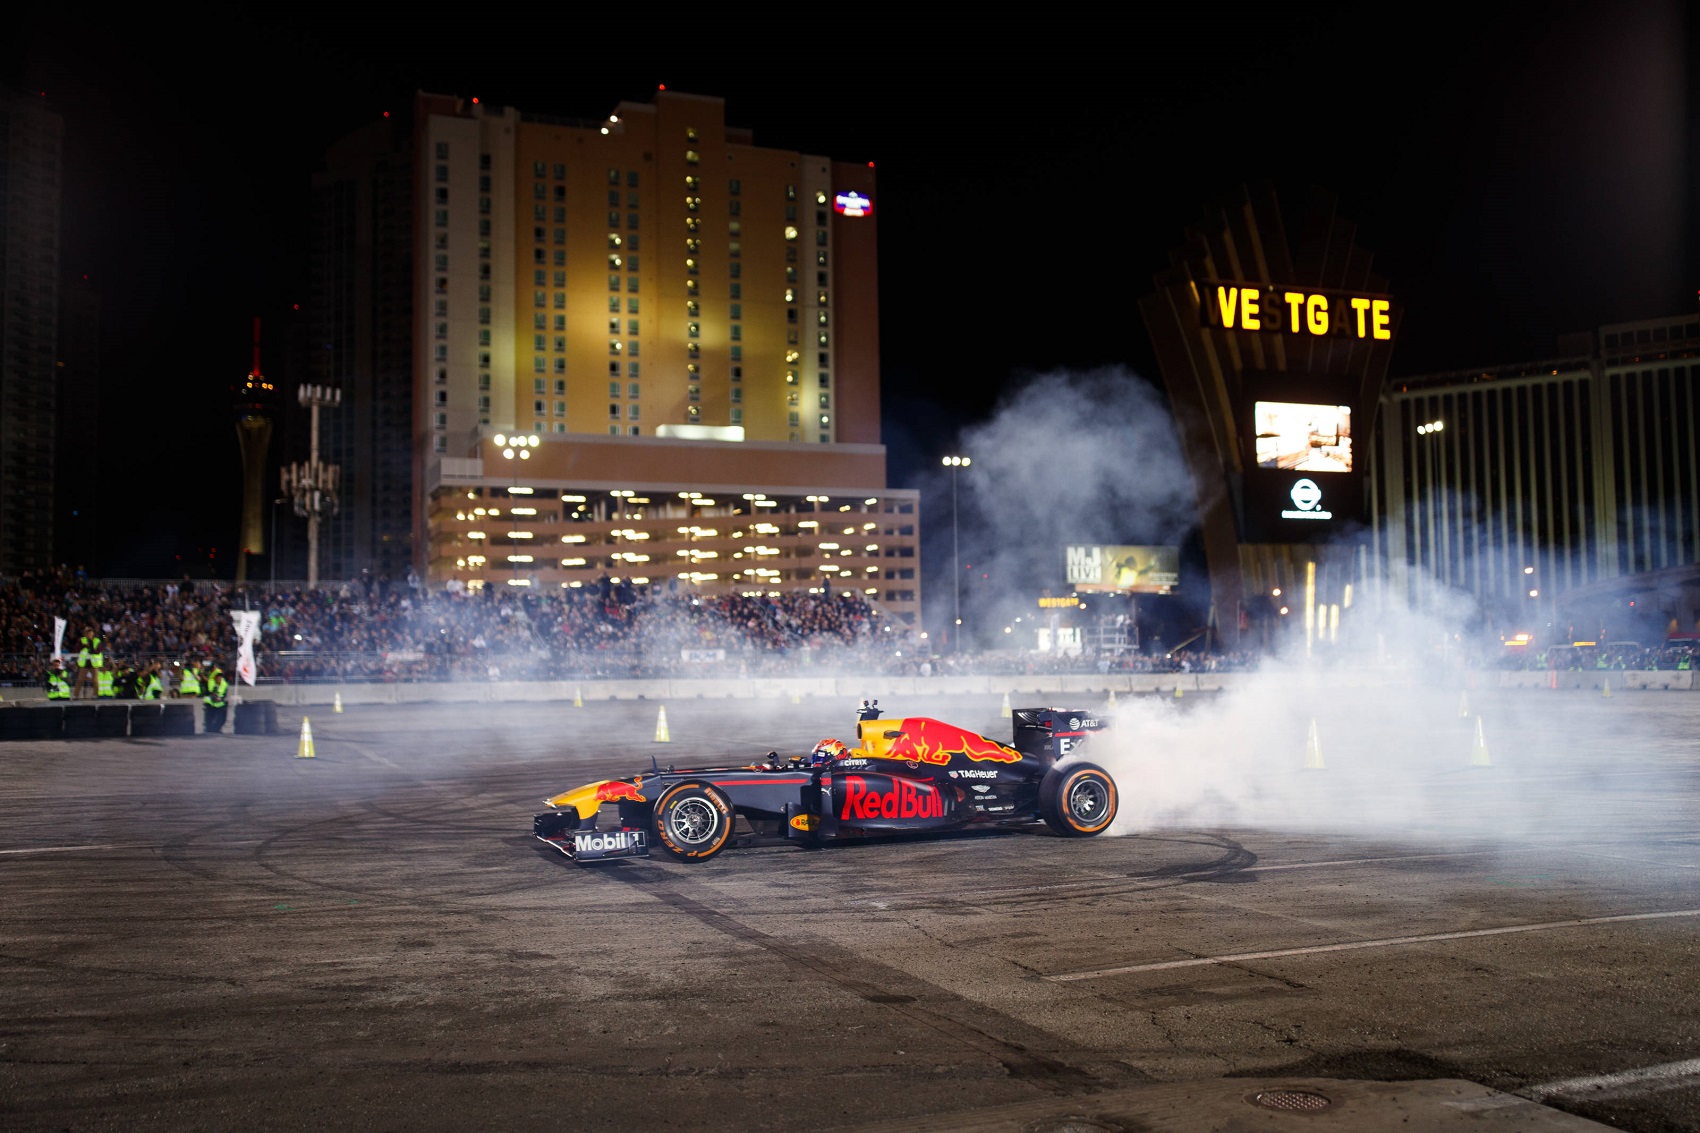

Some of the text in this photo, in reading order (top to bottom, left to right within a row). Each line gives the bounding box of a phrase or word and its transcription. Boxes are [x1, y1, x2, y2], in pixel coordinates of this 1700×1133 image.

[1067, 547, 1101, 565] MJ
[1080, 719, 1099, 728] AT&T
[575, 832, 626, 852] Mobil
